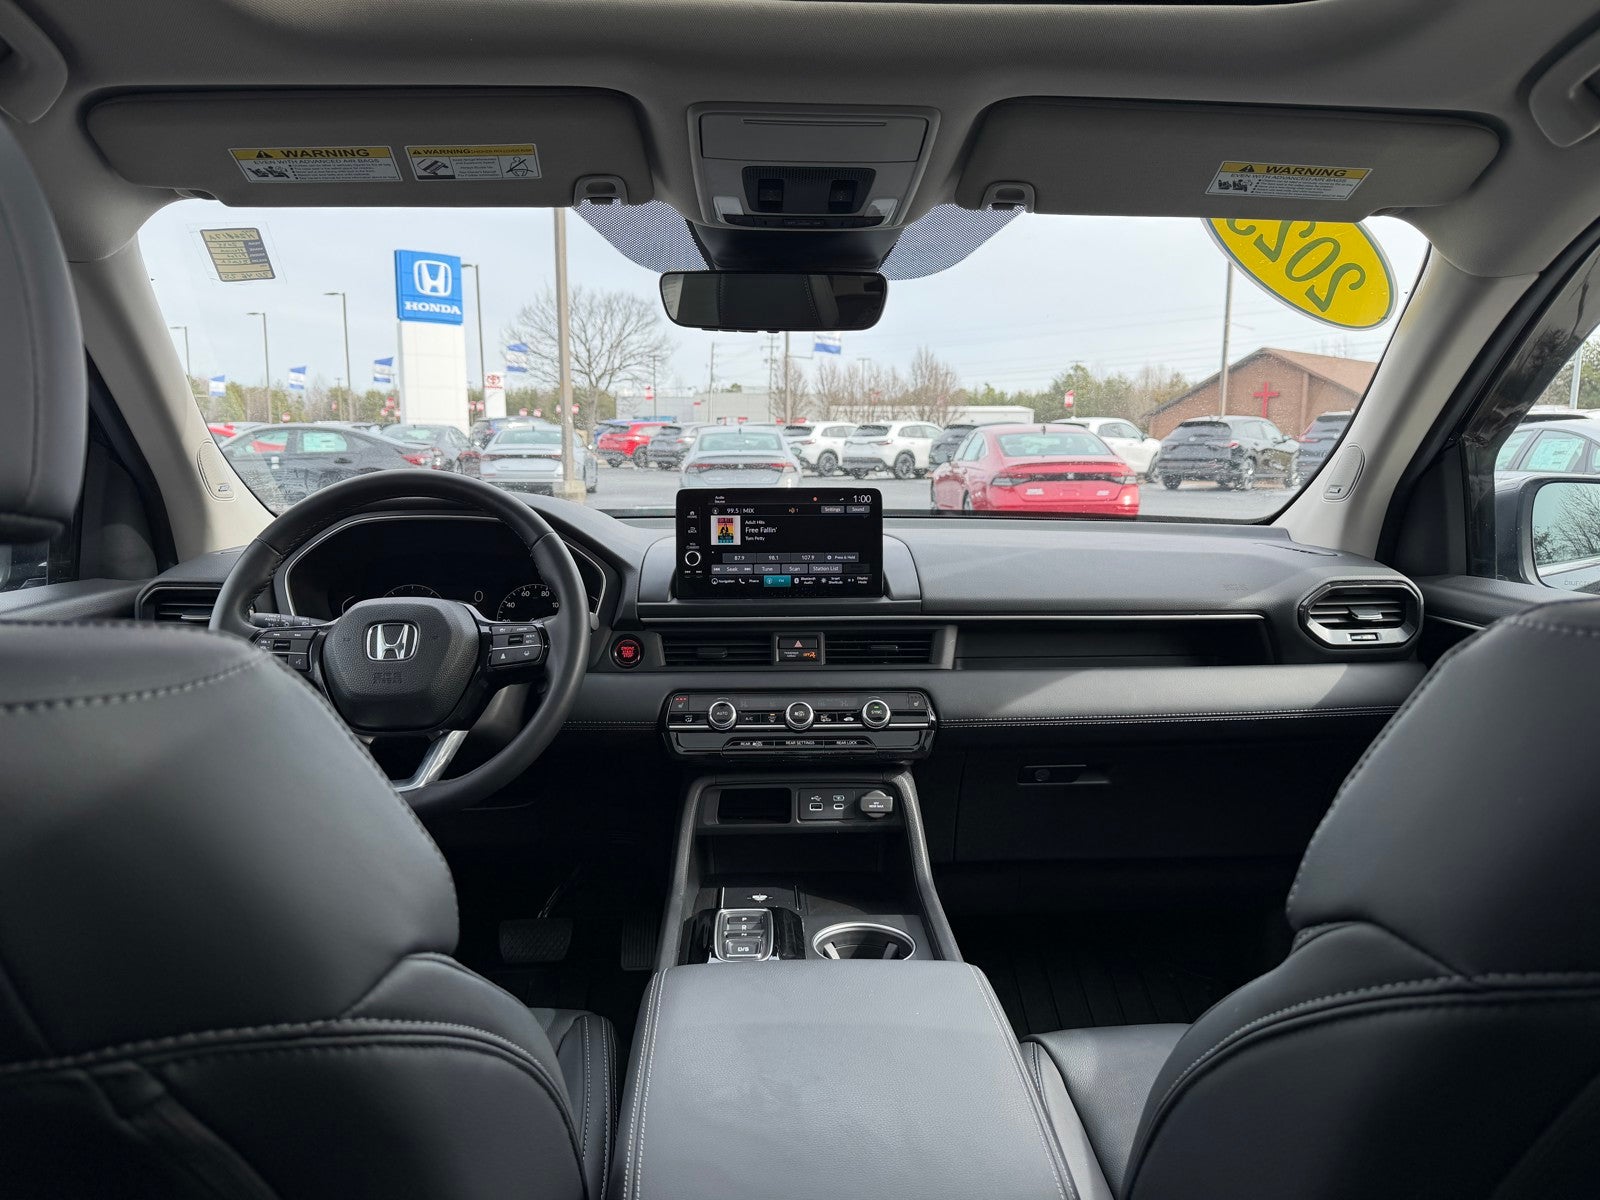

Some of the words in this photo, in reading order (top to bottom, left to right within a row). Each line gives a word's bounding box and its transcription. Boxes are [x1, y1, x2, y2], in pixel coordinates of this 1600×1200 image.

[280, 148, 370, 158] WARNING
[1266, 166, 1348, 176] WARNING
[404, 301, 462, 315] HONDA
[853, 494, 872, 503] 1:00
[474, 590, 484, 602] 0
